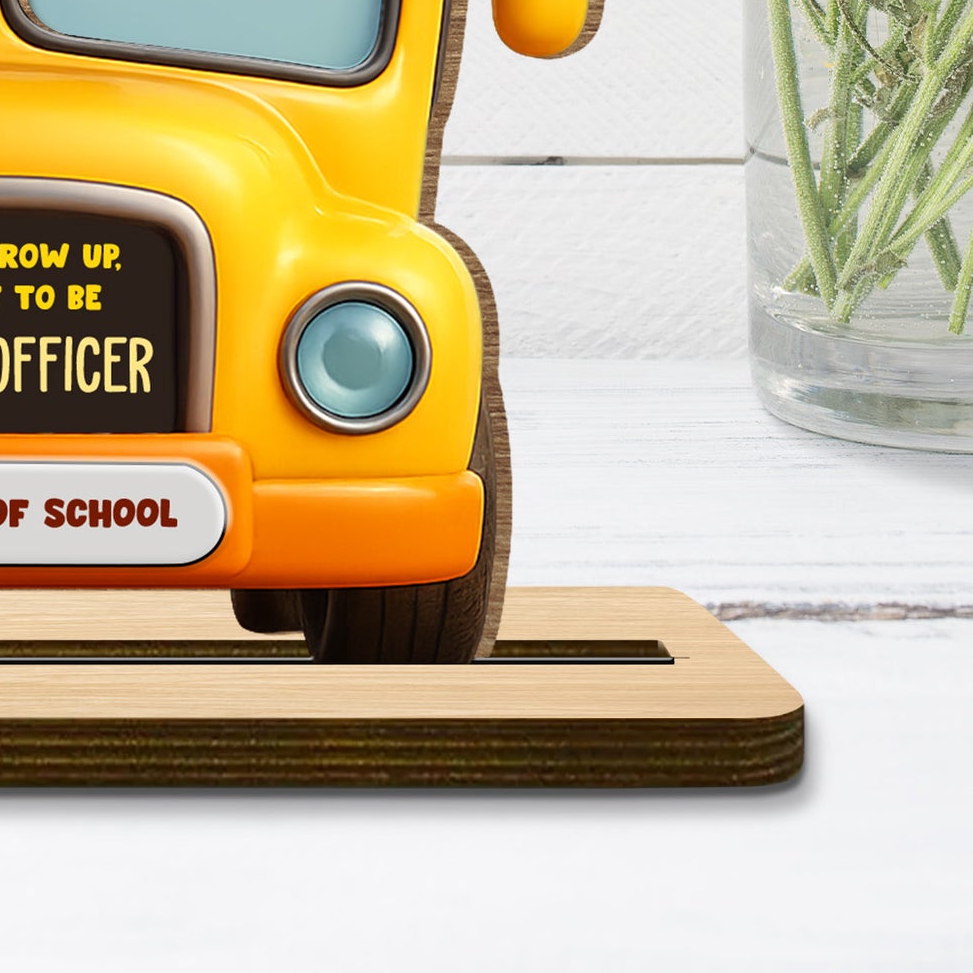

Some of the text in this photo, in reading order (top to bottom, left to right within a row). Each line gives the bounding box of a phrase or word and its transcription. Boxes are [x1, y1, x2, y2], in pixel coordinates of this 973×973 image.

[82, 242, 122, 272] UP,
[14, 284, 55, 311] TO
[67, 284, 102, 311] BE
[43, 498, 178, 528] SCHOOL
